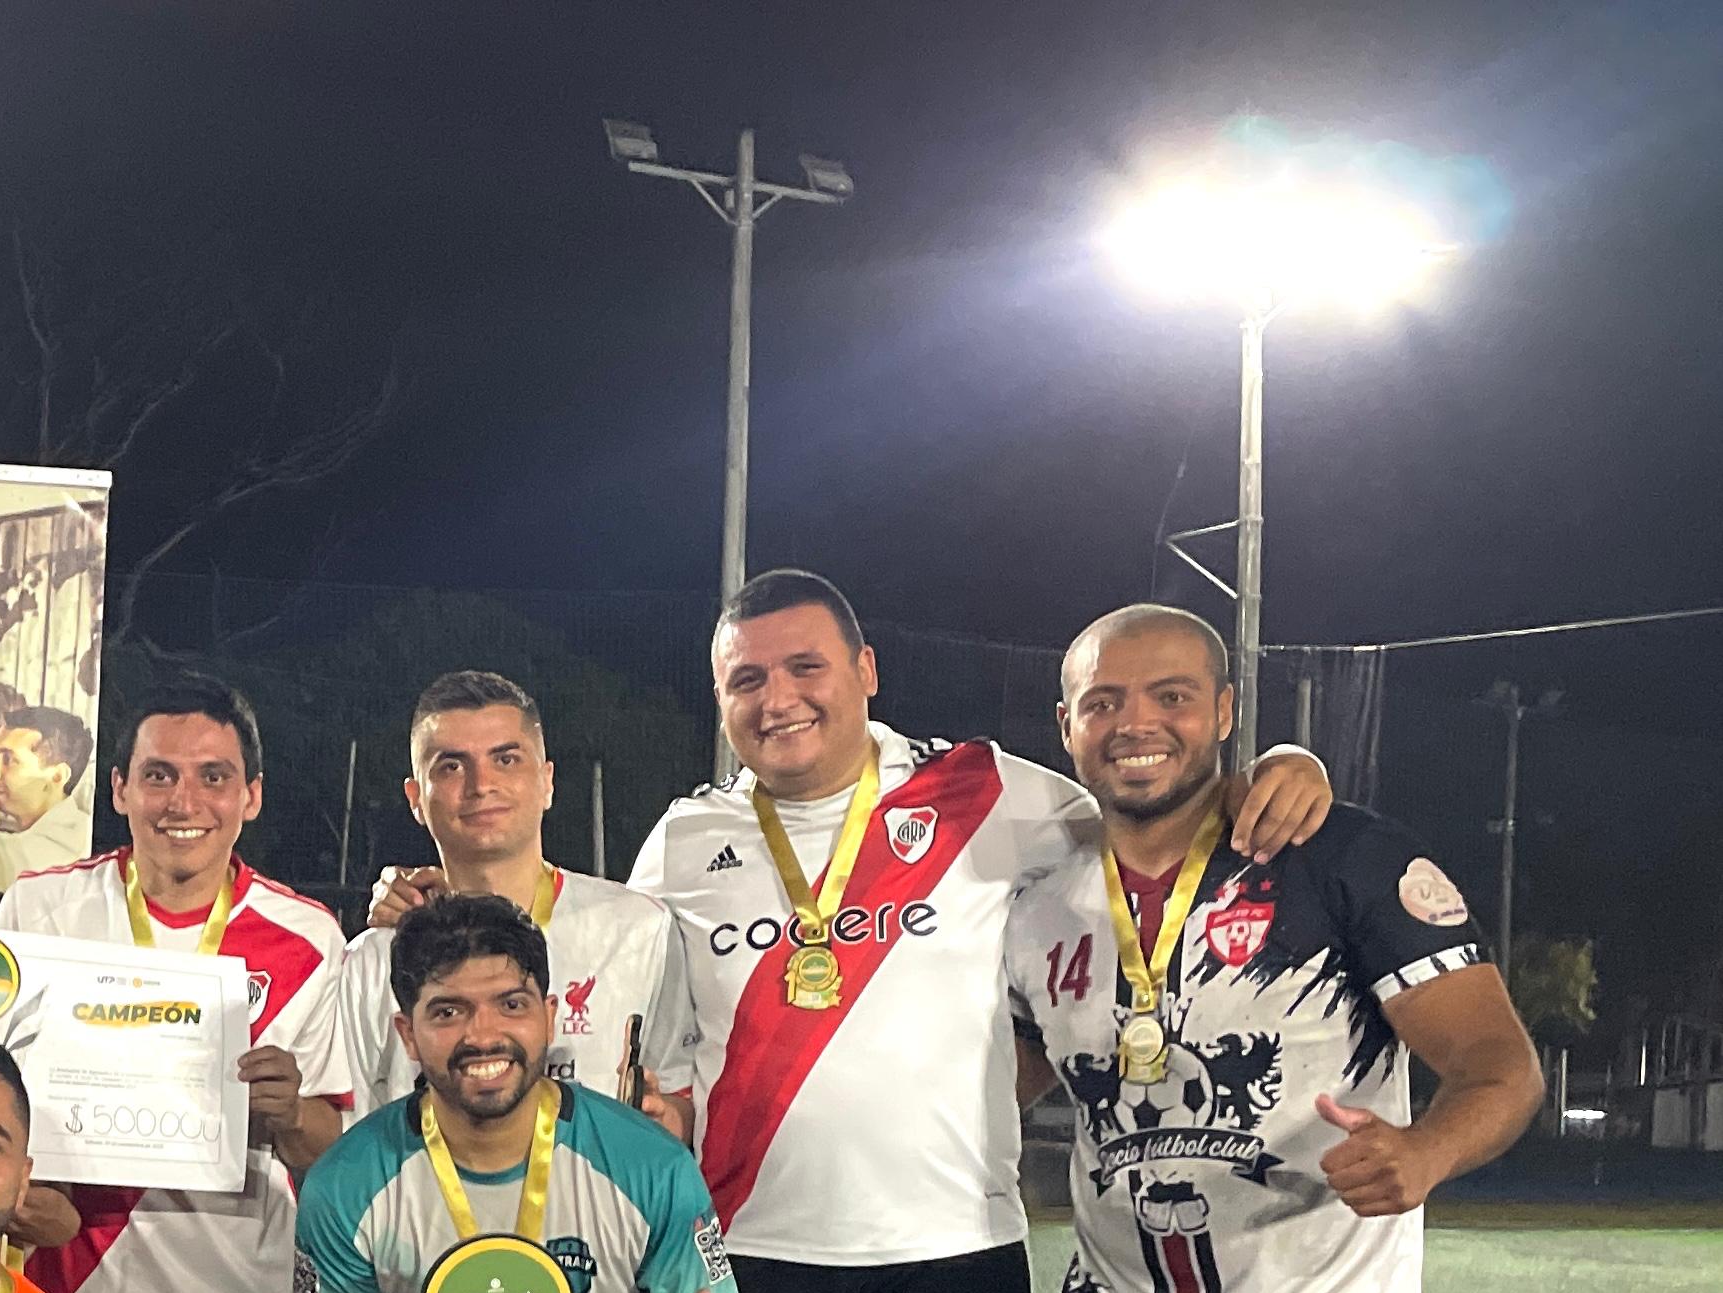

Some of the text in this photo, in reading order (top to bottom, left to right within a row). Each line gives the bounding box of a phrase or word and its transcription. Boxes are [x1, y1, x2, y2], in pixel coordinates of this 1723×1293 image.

[1046, 933, 1093, 1008] 14
[72, 1001, 202, 1025] CAMPEÓN
[1143, 1133, 1209, 1161] fútbol
[1209, 1135, 1261, 1160] club
